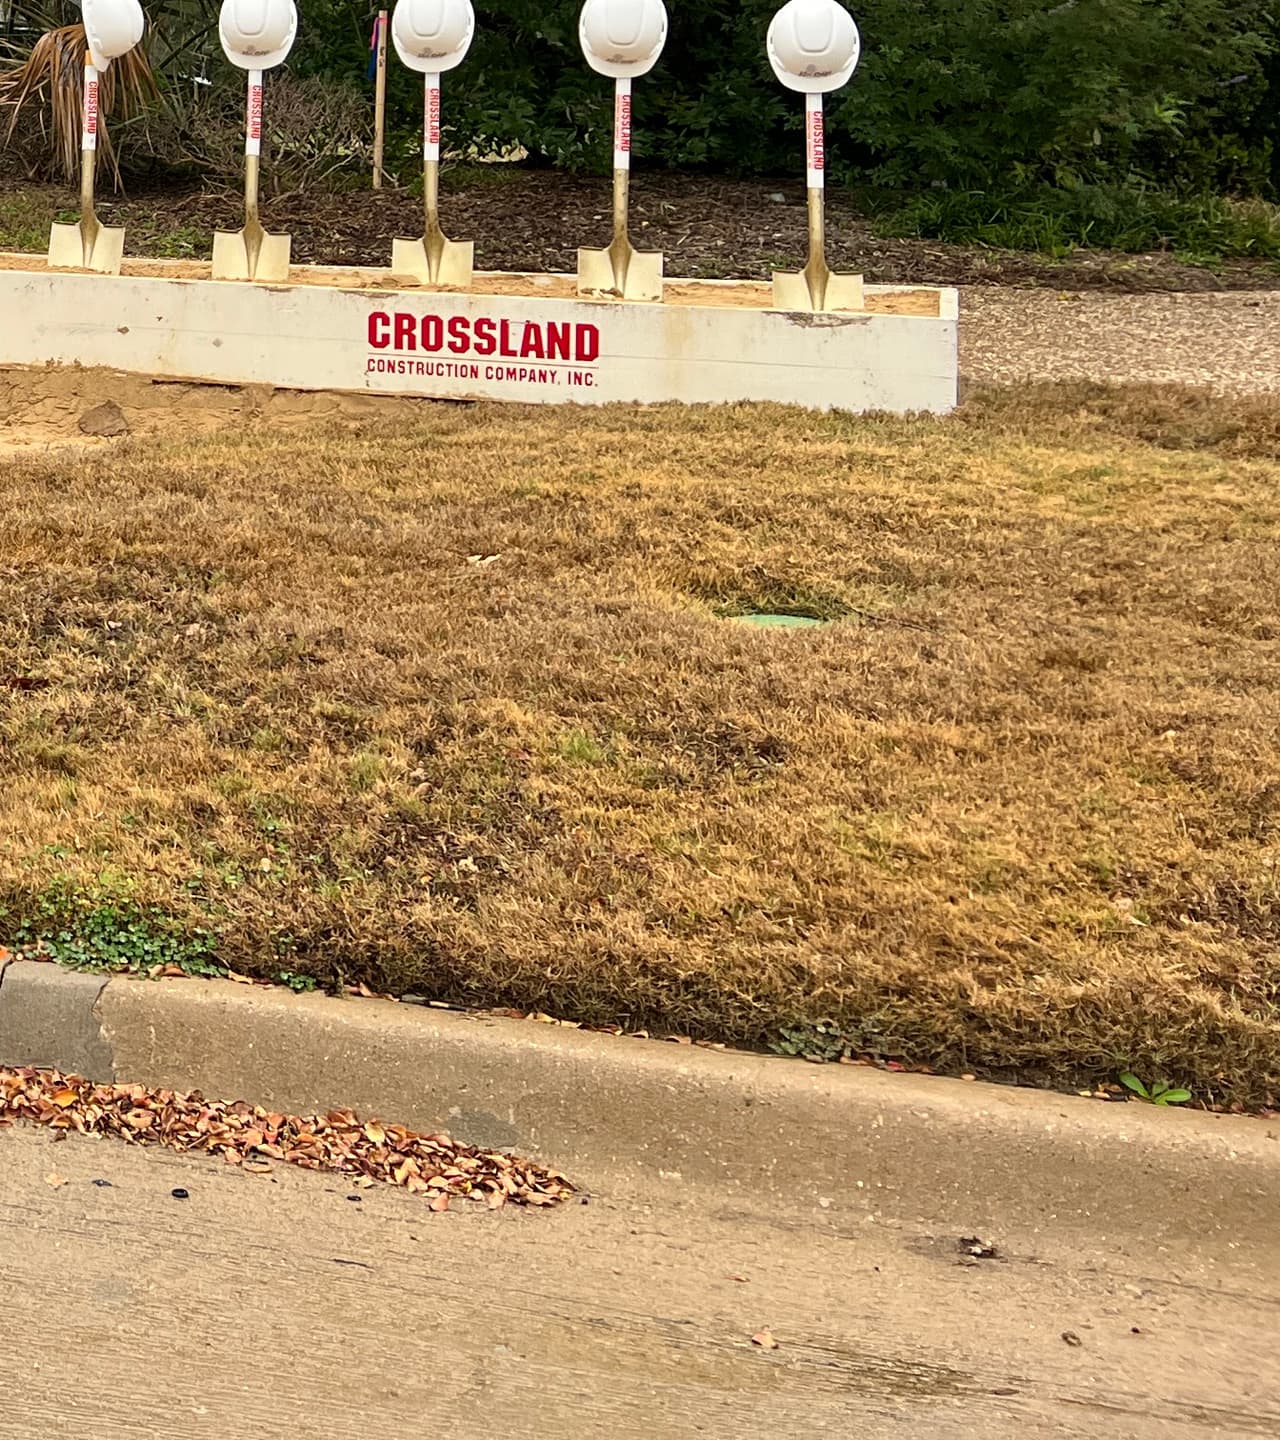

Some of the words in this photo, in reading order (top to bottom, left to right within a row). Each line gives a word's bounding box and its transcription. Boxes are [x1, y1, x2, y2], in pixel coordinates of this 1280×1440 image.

[87, 81, 97, 134] CROSSLAND
[250, 84, 262, 140] CROSSLAND
[429, 88, 439, 144] CROSSLAND
[620, 94, 631, 152] CROSSLAND
[813, 111, 824, 170] CROSSLAND
[368, 311, 600, 362] CROSSLAND
[367, 358, 479, 379] CONSTRUCTION
[485, 366, 561, 385] COMPANY,
[567, 371, 599, 387] INC.
